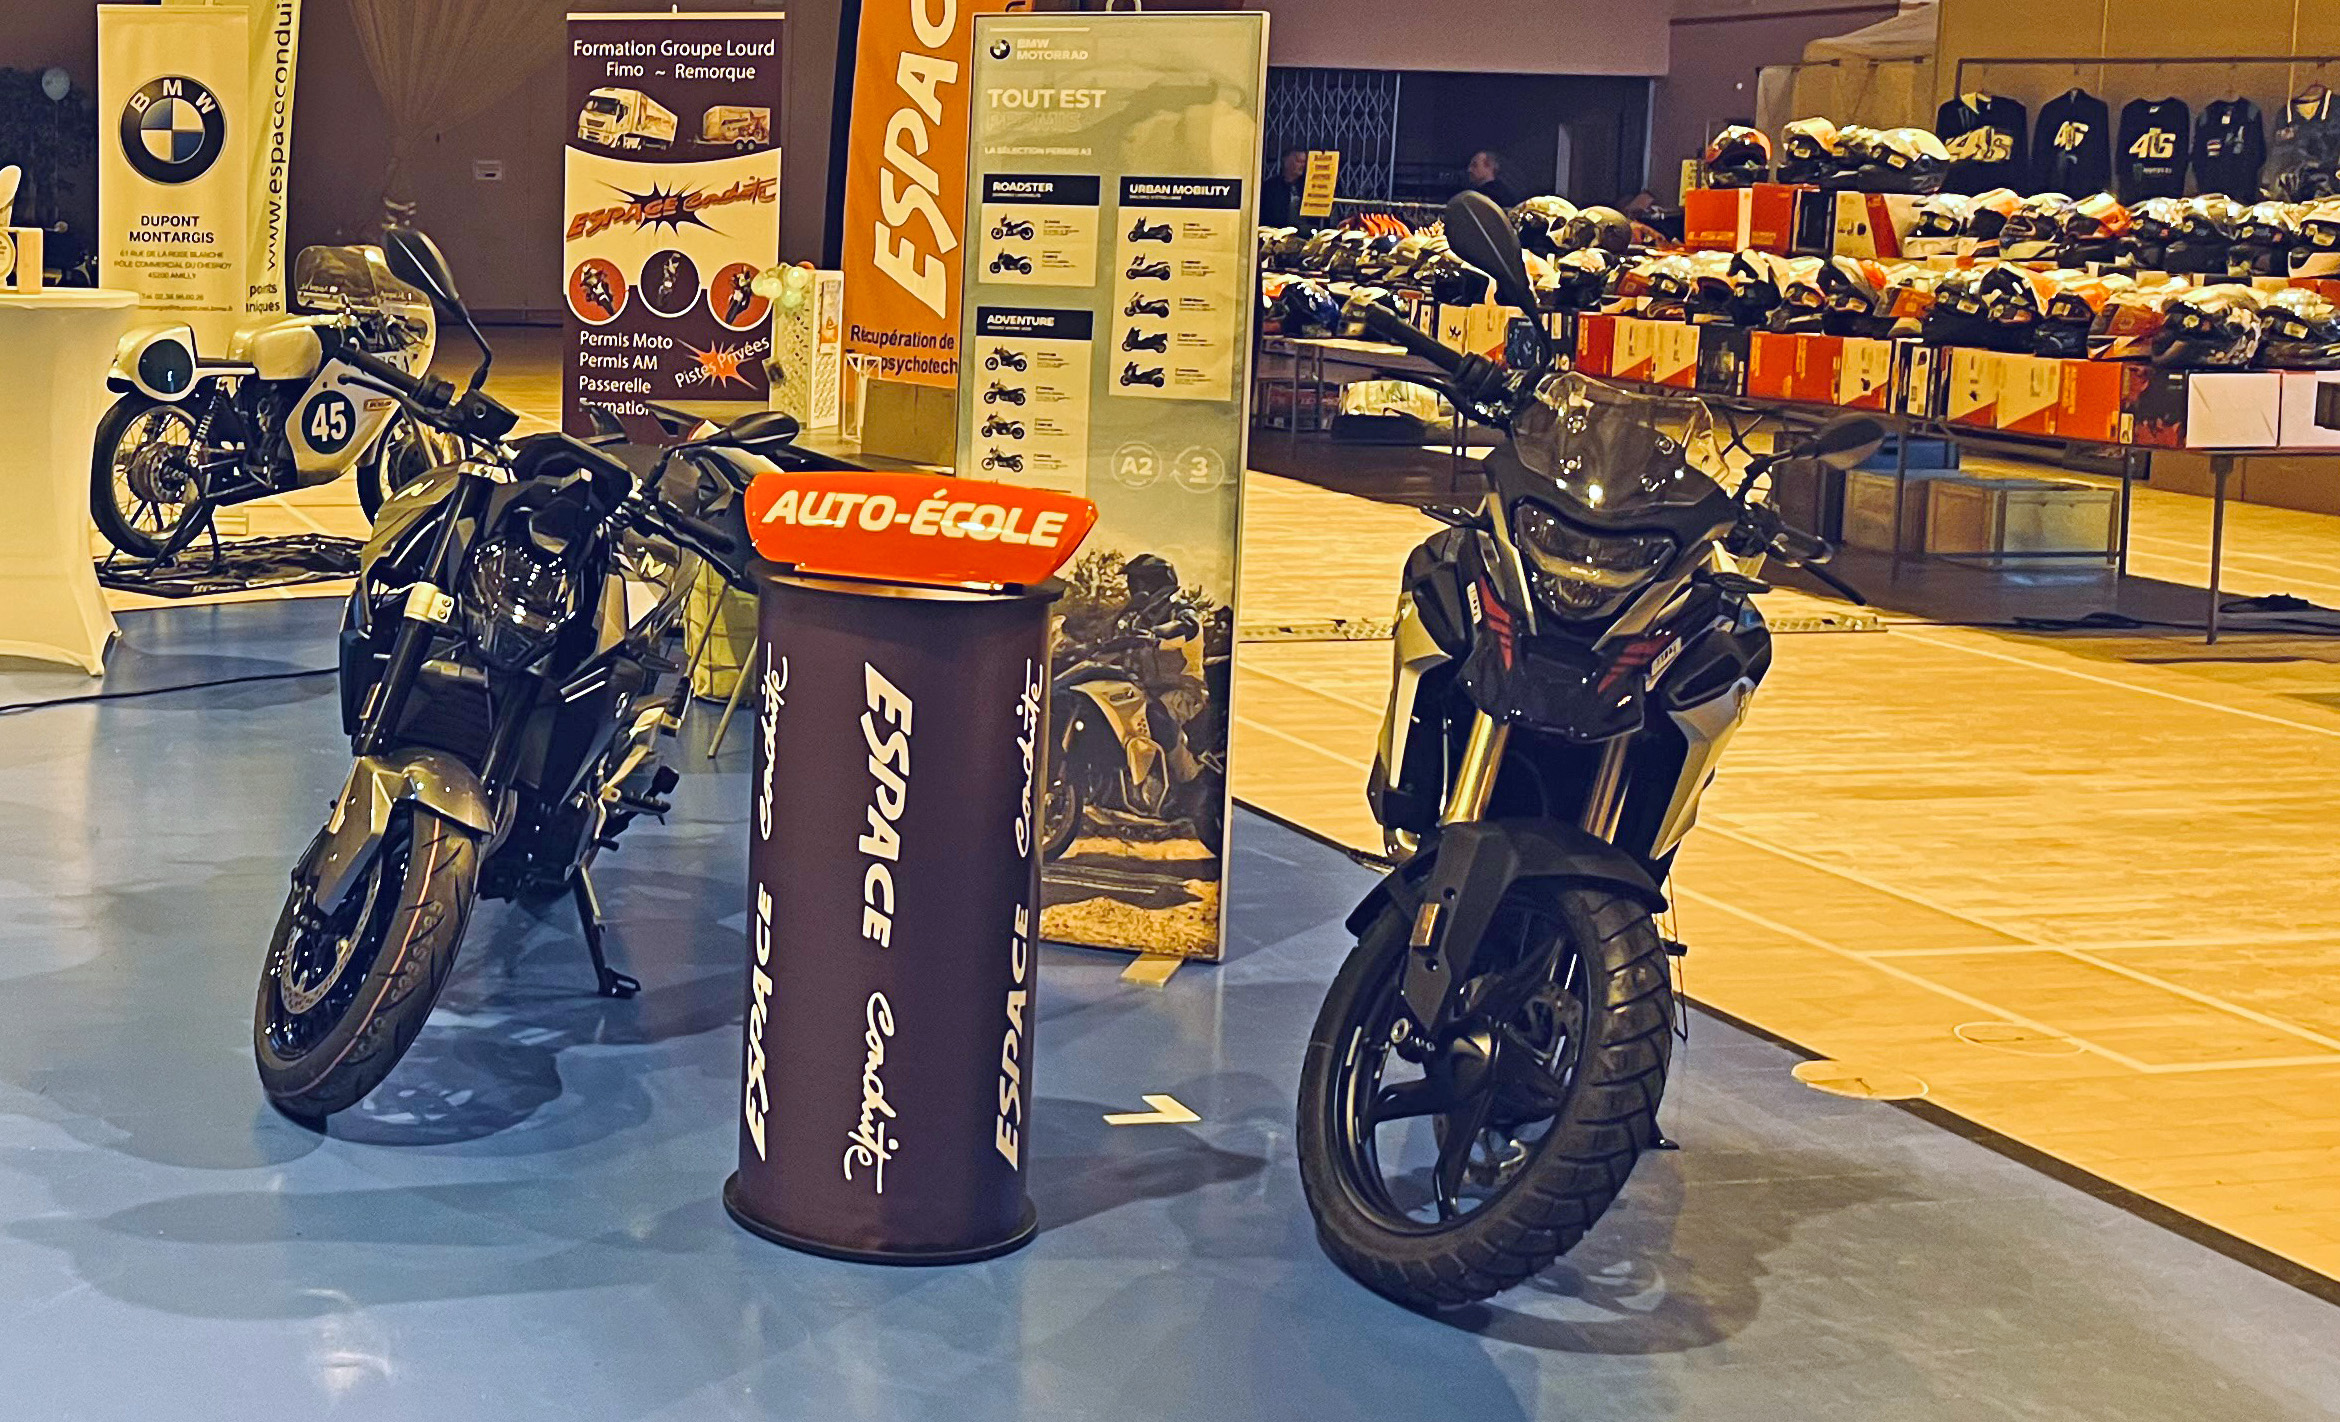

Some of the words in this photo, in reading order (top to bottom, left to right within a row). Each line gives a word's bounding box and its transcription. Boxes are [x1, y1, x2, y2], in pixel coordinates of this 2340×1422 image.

[573, 39, 656, 56] Formation
[660, 39, 722, 59] Groupe
[726, 38, 775, 56] Lourd
[1016, 39, 1050, 49] BMW
[1016, 50, 1088, 60] MOTORRAD
[675, 63, 756, 82] Remorque
[130, 79, 216, 114] BMW
[987, 88, 1056, 108] TOUT
[1059, 89, 1107, 108] EST
[267, 0, 294, 272] www.espacecondui
[2128, 127, 2177, 159] 46
[873, 0, 959, 320] ESPAC
[992, 181, 1054, 193] ROADSTER
[1129, 183, 1171, 194] URBAN
[1172, 184, 1231, 196] MOBILITY
[140, 215, 200, 228] DUPONT
[566, 195, 678, 243] ESPACE
[129, 231, 215, 244] MONTARGIS
[986, 314, 1056, 327] ADVENTURE
[579, 330, 629, 348] Permis
[632, 331, 674, 350] Moto
[850, 324, 937, 350] Récupération
[939, 333, 955, 350] de
[579, 352, 628, 369] Permis
[631, 355, 659, 371] AM
[674, 361, 718, 389] Pistes
[716, 336, 770, 369] Privées
[579, 375, 652, 395] Passerelle
[310, 401, 348, 442] 45
[1120, 456, 1153, 476] A2
[761, 488, 1069, 548] AUTO-ÉCOLE
[858, 661, 914, 949] ESPACE
[996, 903, 1030, 1173] ESPACE
[1015, 658, 1044, 859] Conduite
[745, 882, 774, 1162] ESPACE
[843, 991, 900, 1195] Conduite
